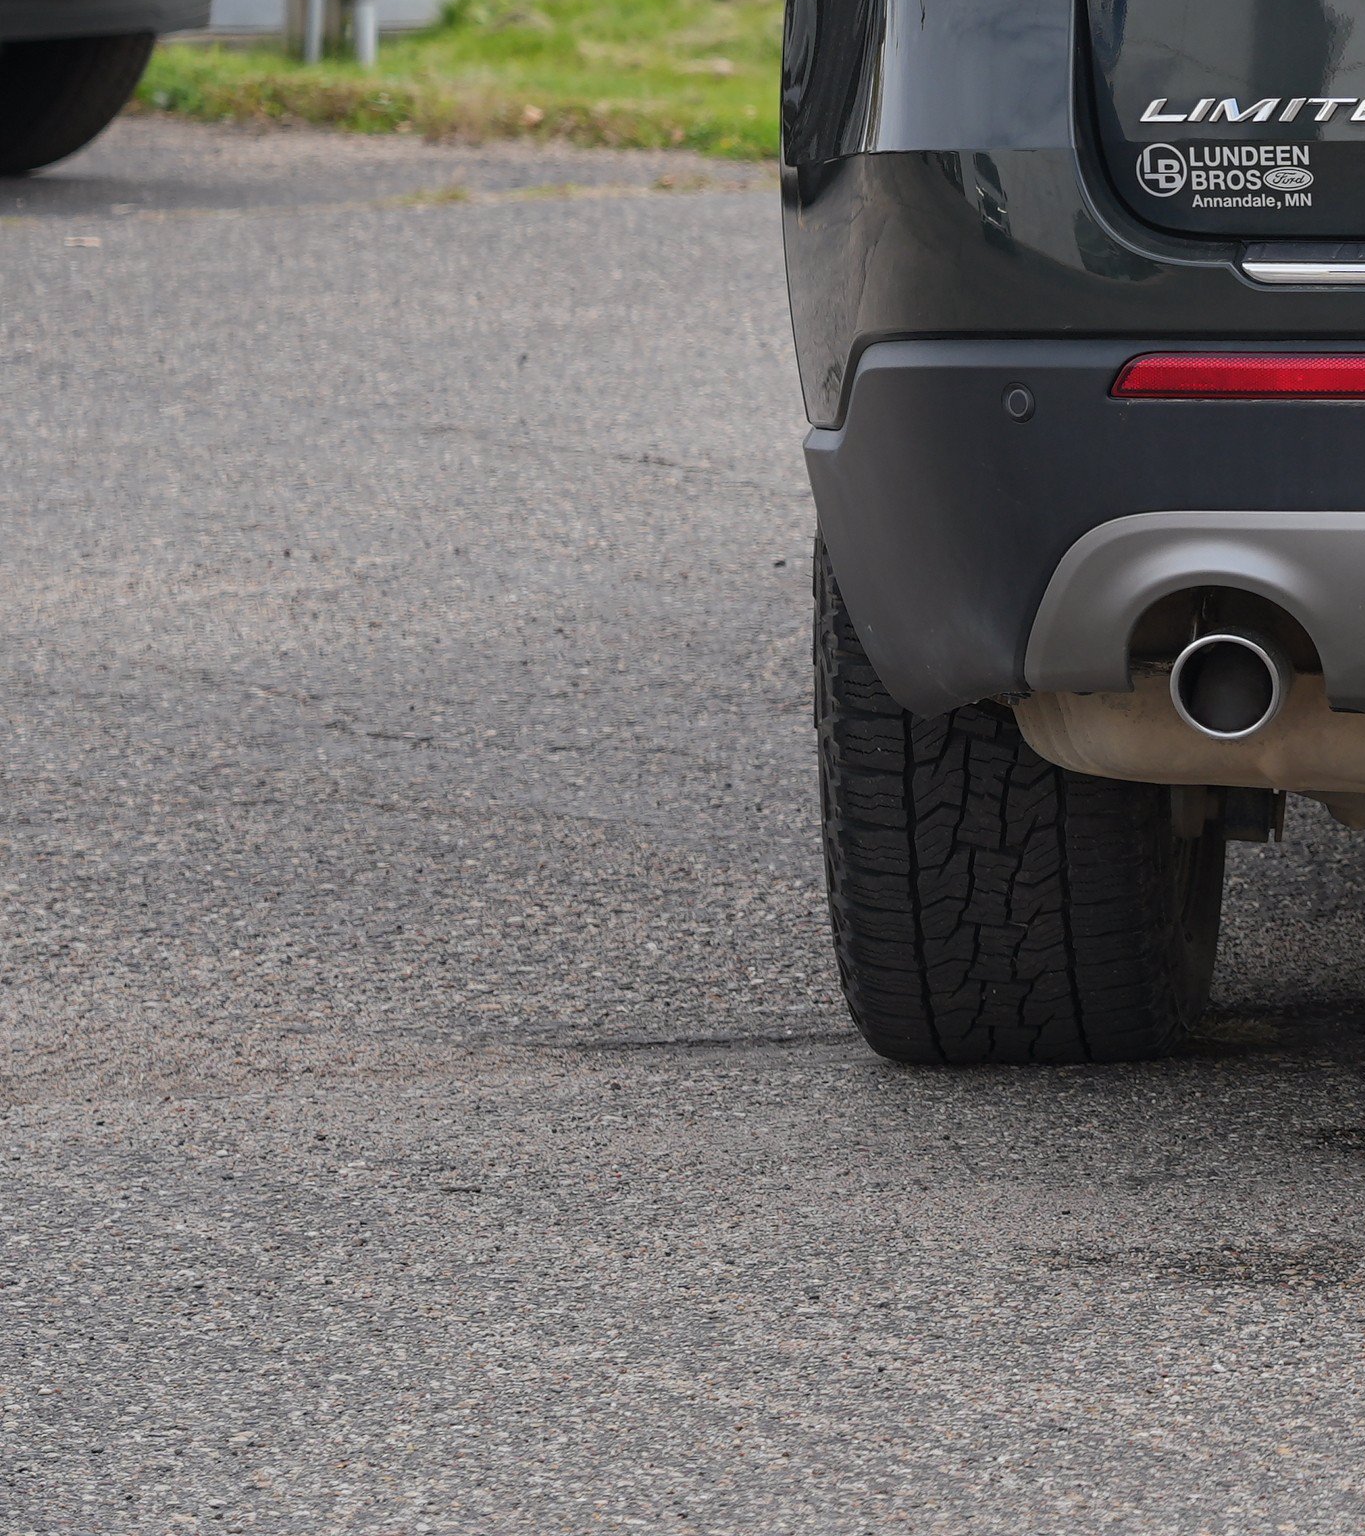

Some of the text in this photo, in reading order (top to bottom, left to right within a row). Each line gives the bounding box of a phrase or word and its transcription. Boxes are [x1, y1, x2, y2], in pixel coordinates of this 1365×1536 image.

[1188, 145, 1310, 167] LUNDEEN
[1190, 168, 1263, 191] BROS
[1192, 193, 1313, 210] Annandale, MN
